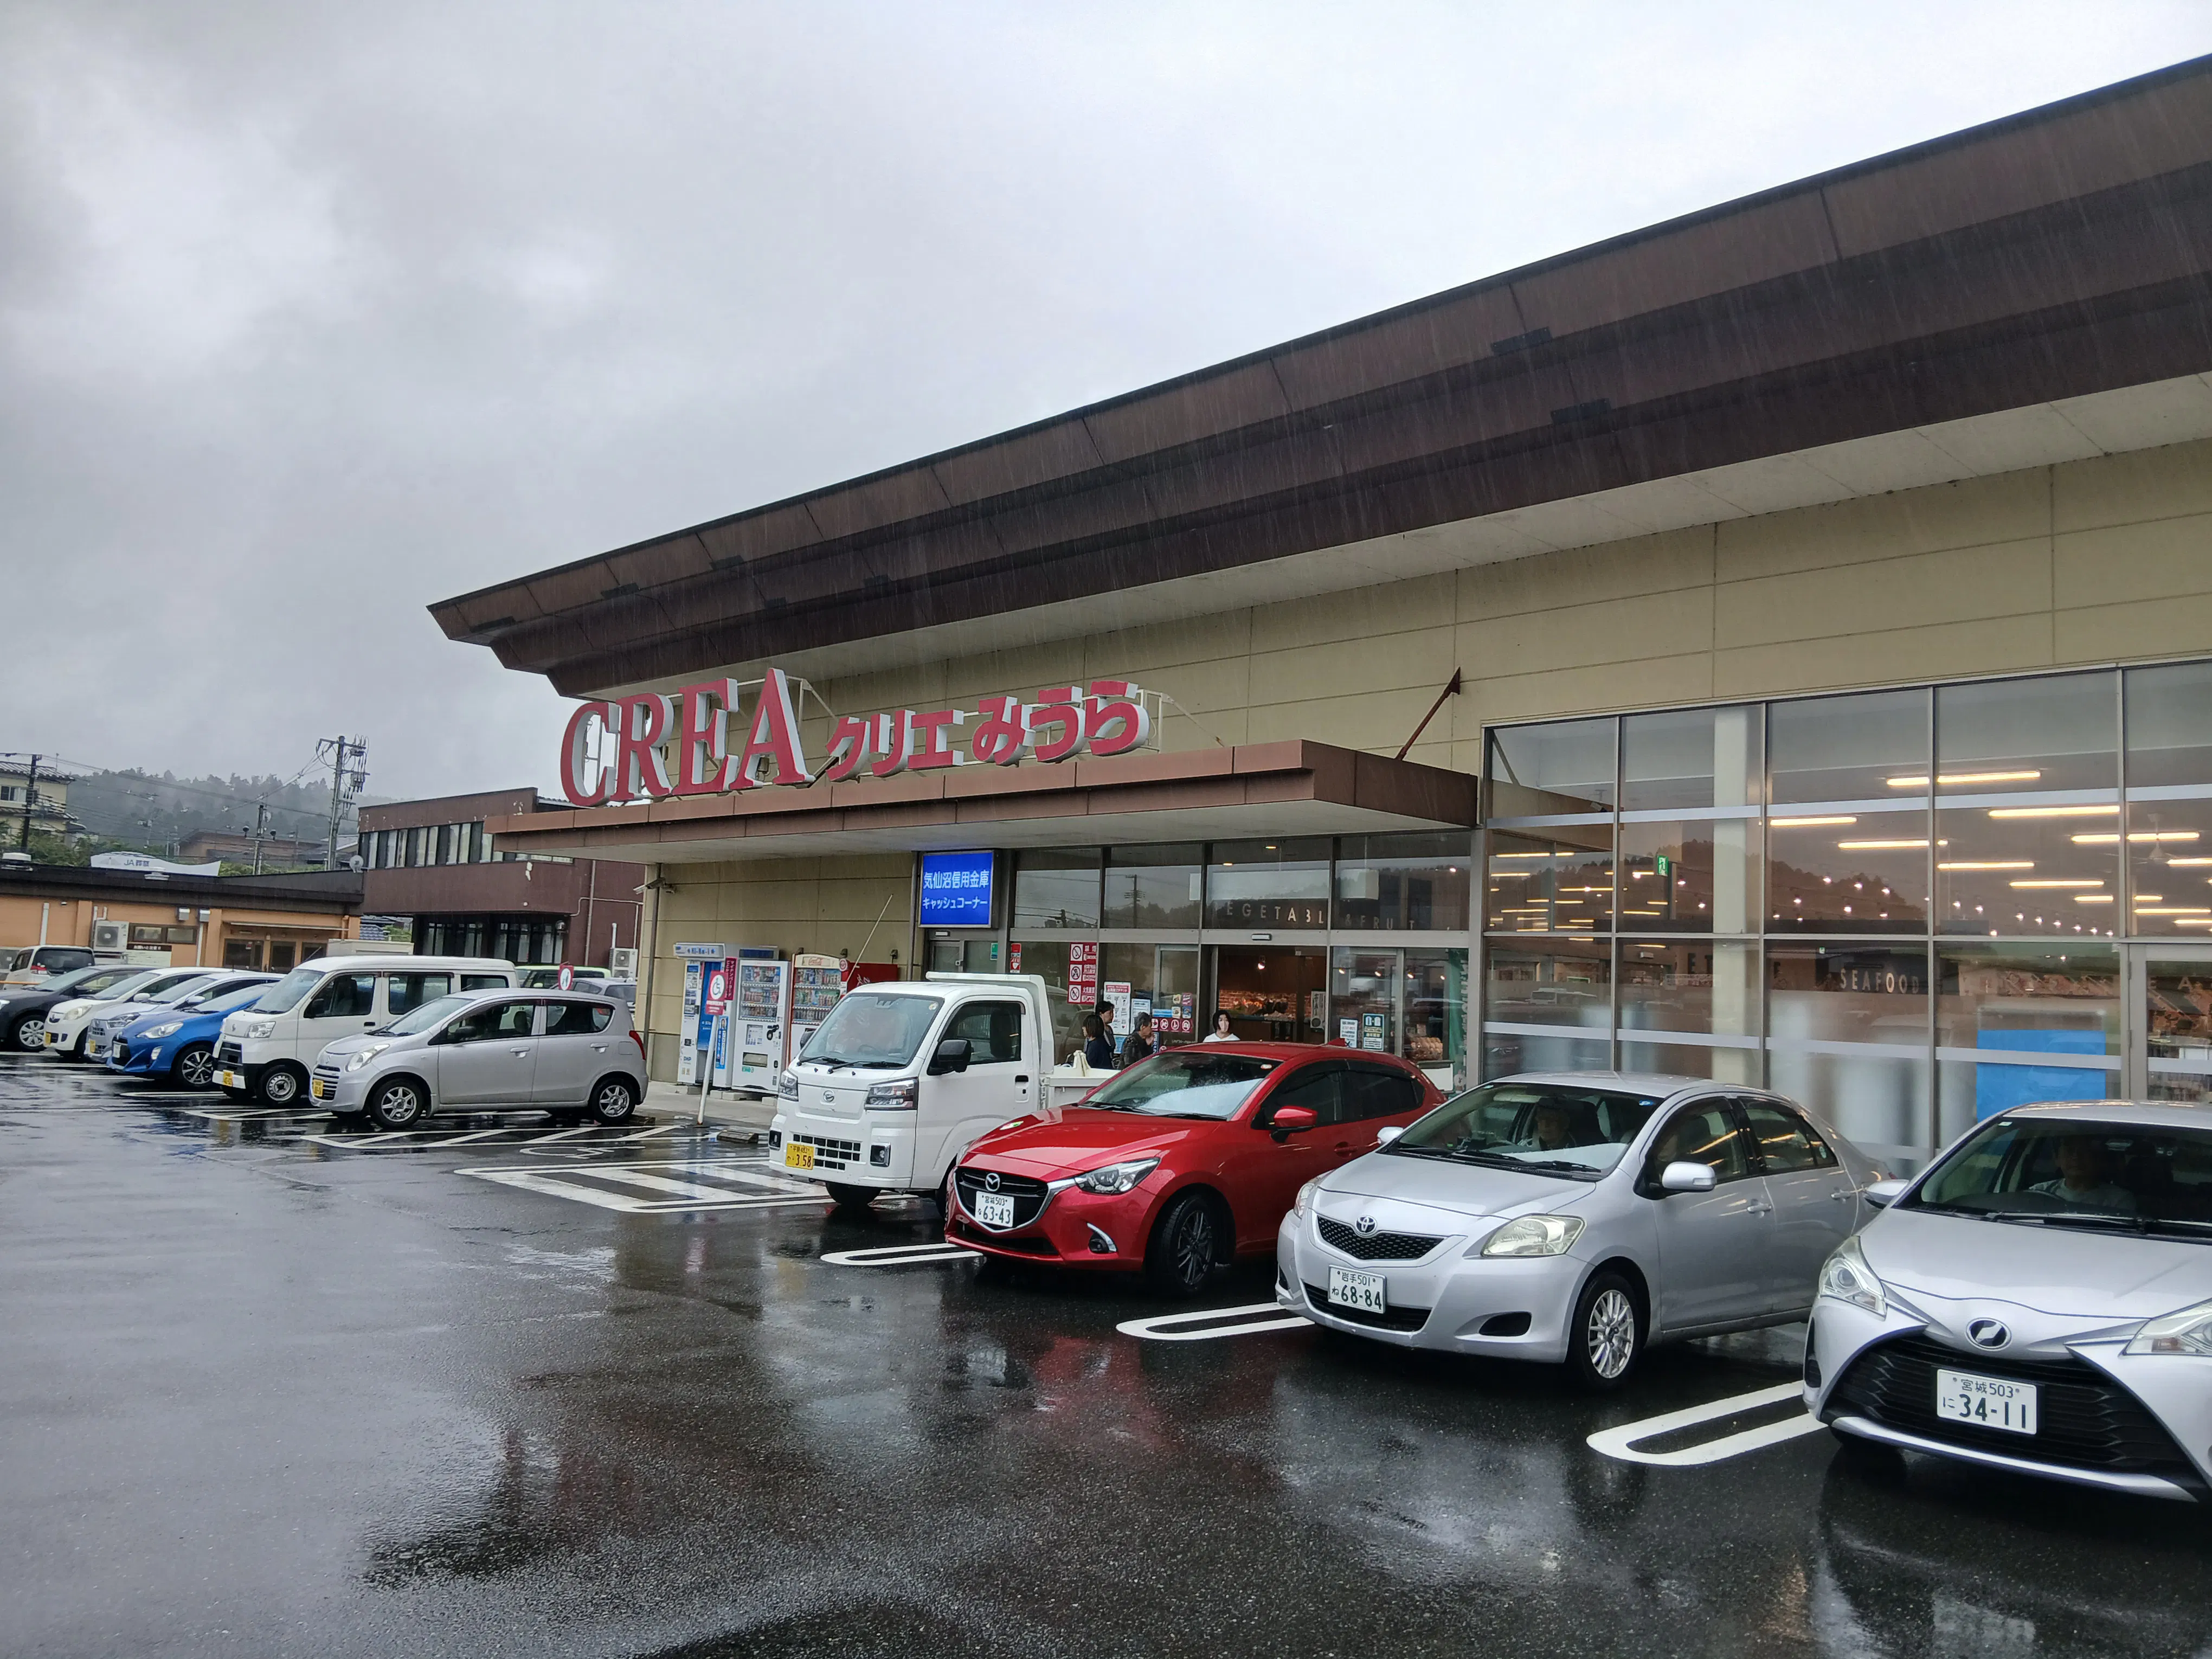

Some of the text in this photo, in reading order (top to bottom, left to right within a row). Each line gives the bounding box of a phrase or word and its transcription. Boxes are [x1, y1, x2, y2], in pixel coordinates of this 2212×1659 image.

[561, 667, 814, 807] CREA
[923, 870, 989, 889] 気仙沼信用金庫
[922, 896, 988, 909] キャッシュコーナー
[1840, 968, 1919, 994] SEAFOOD
[1332, 1284, 1382, 1310] ね 68-84
[1943, 1393, 2026, 1429] に 34-11
